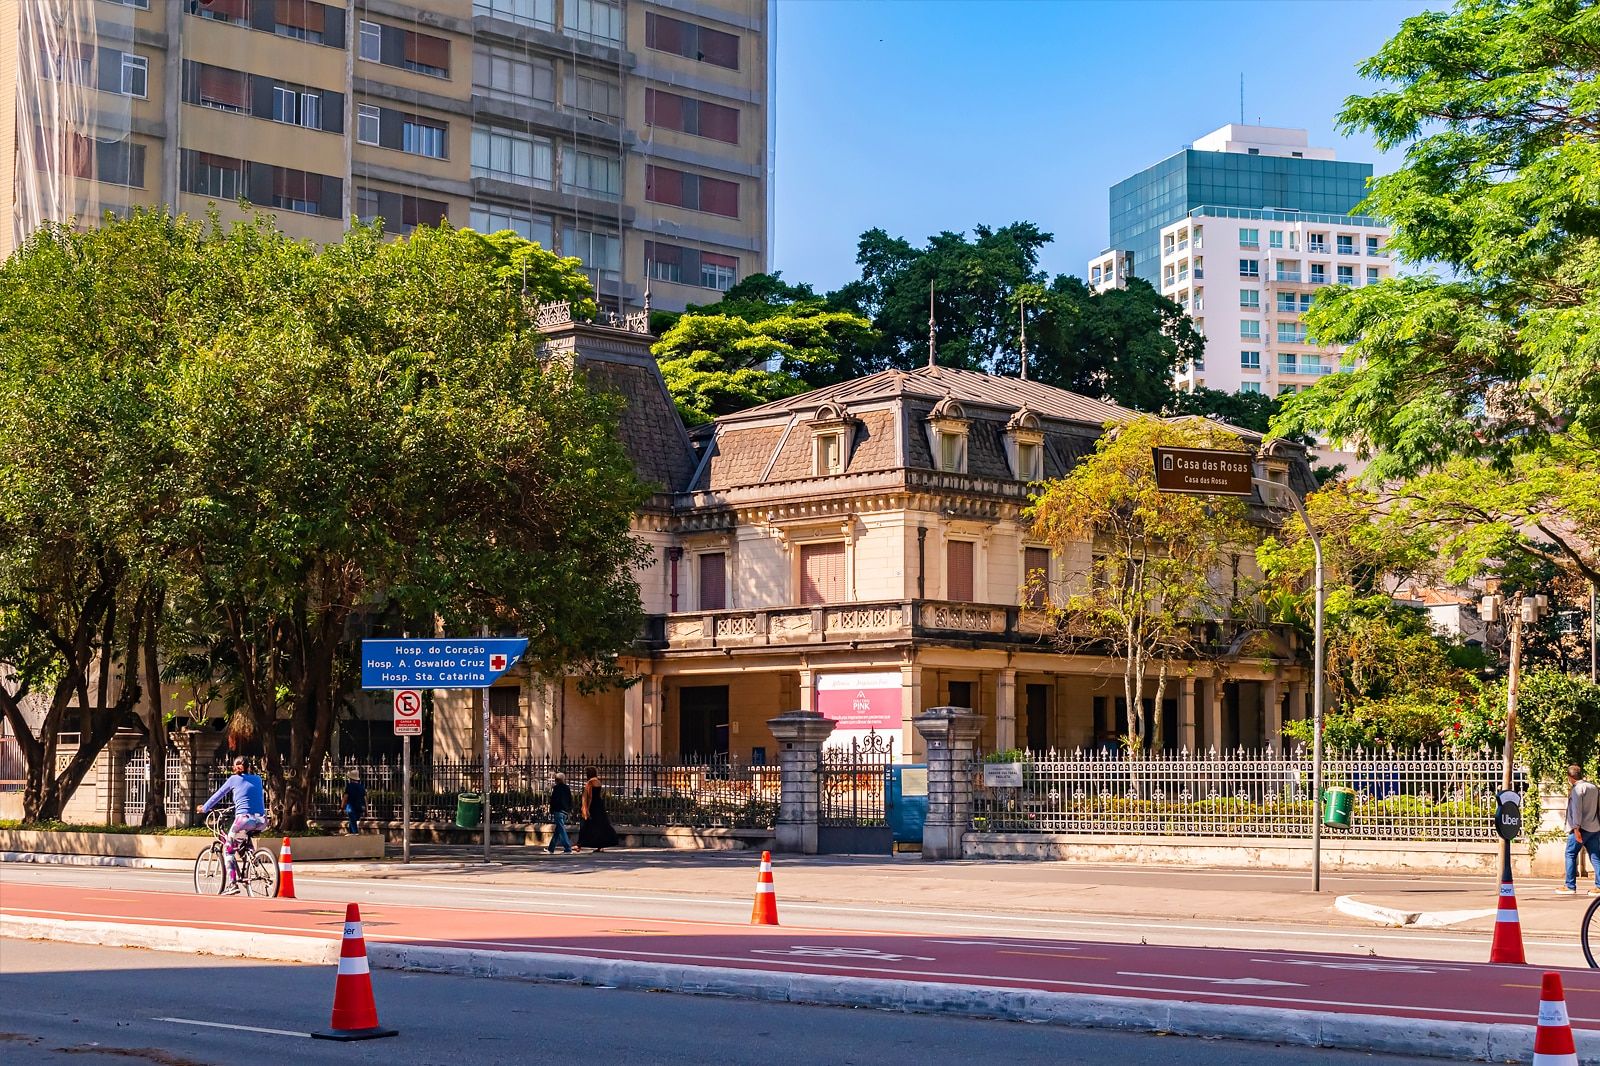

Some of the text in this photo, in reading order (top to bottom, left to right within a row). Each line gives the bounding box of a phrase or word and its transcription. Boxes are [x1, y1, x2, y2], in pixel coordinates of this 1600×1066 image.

[1177, 458, 1247, 472] Casa das Rosas
[1200, 476, 1210, 484] das
[1211, 477, 1228, 485] Rosas
[396, 646, 485, 656] Hosp. do Coração
[368, 659, 485, 669] Hosp. A. Oswaldo Cruz
[382, 673, 410, 682] Hosp.
[415, 673, 435, 681] Sta.
[853, 702, 870, 710] PINK
[1502, 814, 1518, 825] Uber
